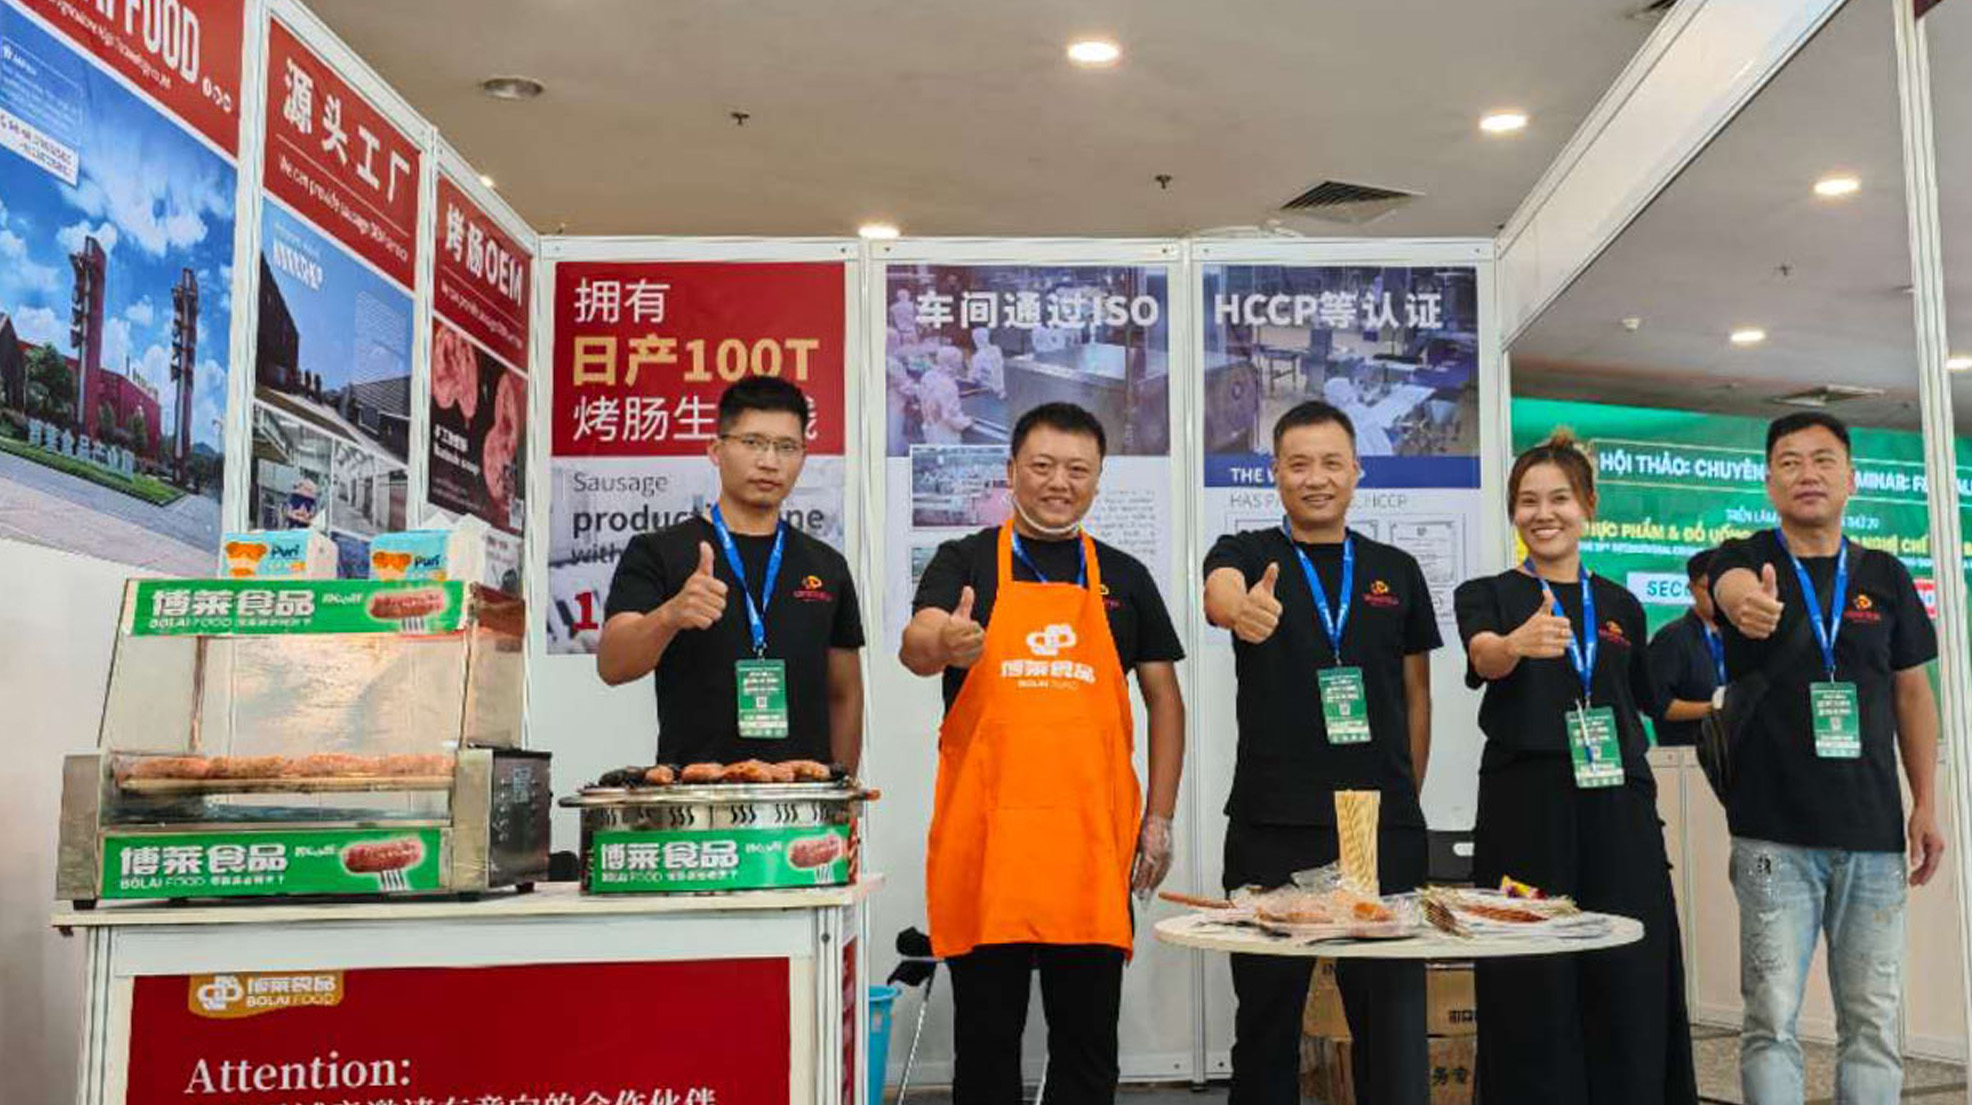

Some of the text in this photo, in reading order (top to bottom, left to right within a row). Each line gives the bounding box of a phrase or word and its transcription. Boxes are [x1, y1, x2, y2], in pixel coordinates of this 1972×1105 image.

[283, 56, 411, 204] 源头工厂
[573, 277, 671, 324] 拥有
[914, 289, 1160, 329] 车间通过ISO
[1213, 290, 1444, 329] HCCP等认证
[572, 332, 820, 387] 日产100T
[572, 394, 818, 442] 烤肠生
[572, 471, 669, 497] Sausage
[1230, 467, 1264, 484] THE
[1599, 448, 1632, 476] HỘI
[1635, 450, 1690, 477] THẢO:
[1854, 470, 1911, 493] MINAR:
[271, 544, 300, 560] Puri
[414, 554, 441, 568] Puri
[152, 588, 315, 619] 博莱食品
[119, 844, 289, 876] 博莱食品
[600, 840, 740, 871] 博莱食品
[183, 1050, 411, 1095] Attention:
